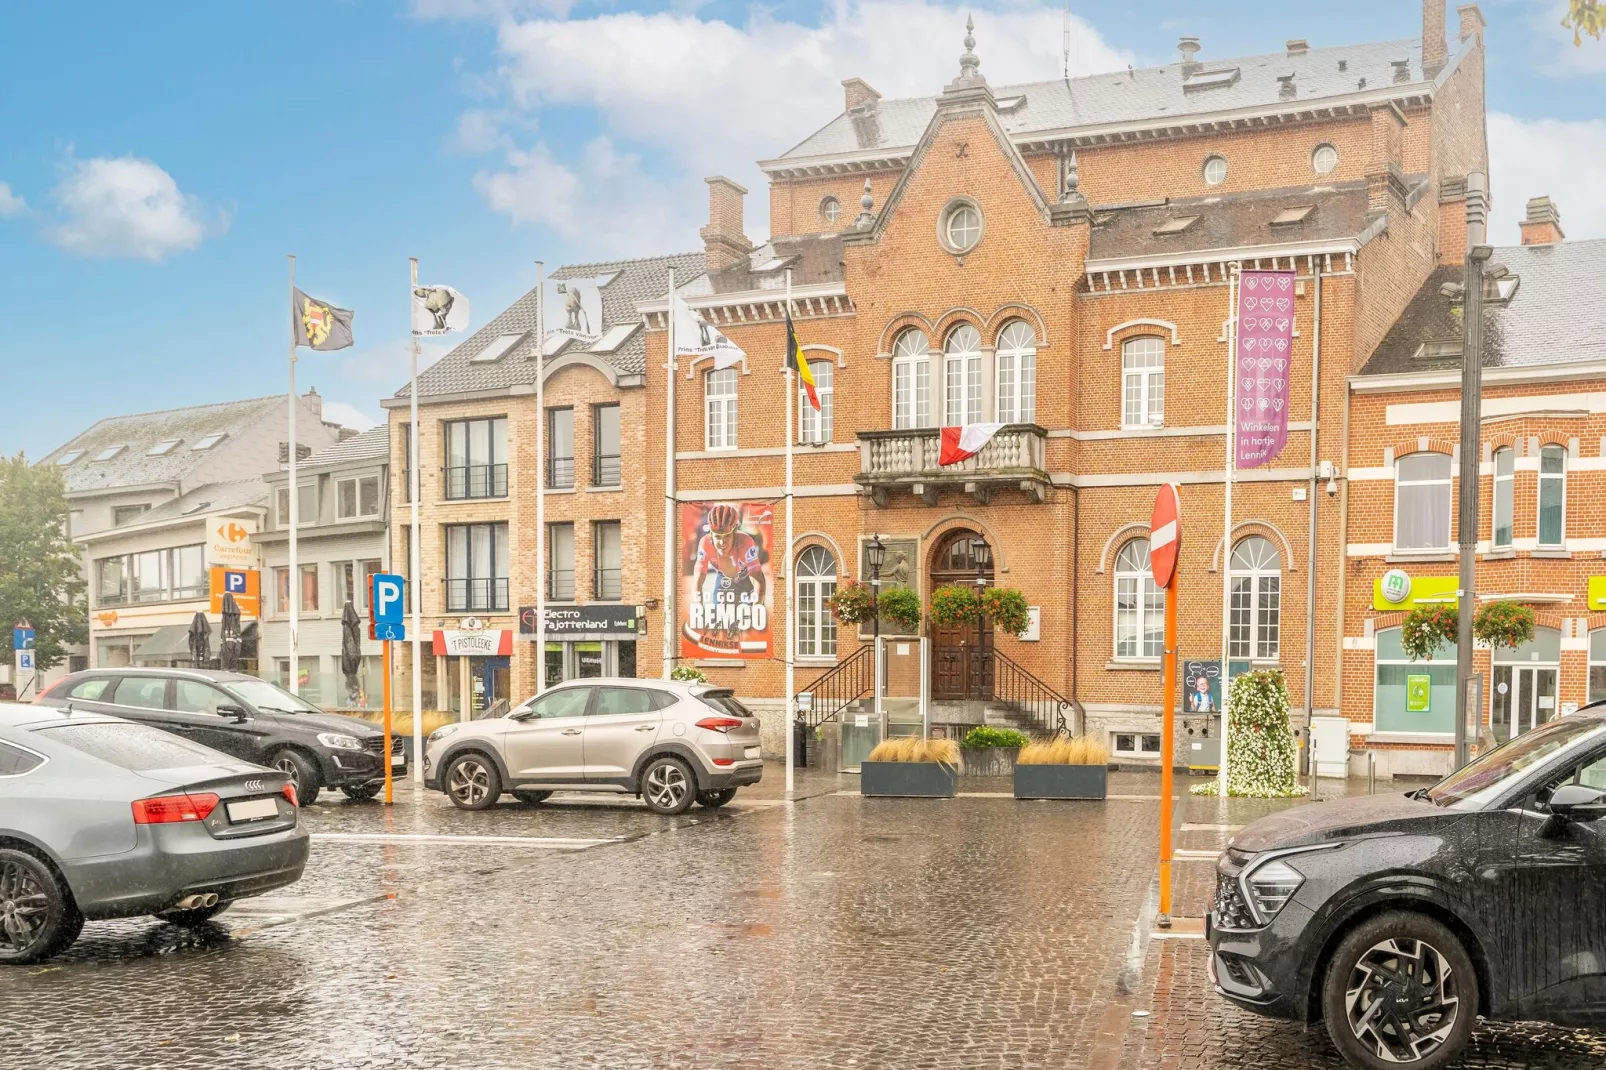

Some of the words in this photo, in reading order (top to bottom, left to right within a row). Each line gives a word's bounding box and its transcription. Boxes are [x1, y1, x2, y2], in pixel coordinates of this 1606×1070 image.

[1241, 422, 1280, 432] Winkelen
[1241, 436, 1249, 446] in
[1241, 449, 1267, 460] Lennik
[214, 544, 252, 554] Carrefour
[229, 574, 243, 591] P
[378, 581, 400, 616] P
[717, 591, 735, 603] GO
[740, 591, 759, 603] GO
[543, 609, 580, 618] Electro
[690, 603, 767, 631] REMCO
[544, 619, 608, 630] Pajottenland
[458, 637, 492, 651] PISTOLEEKE
